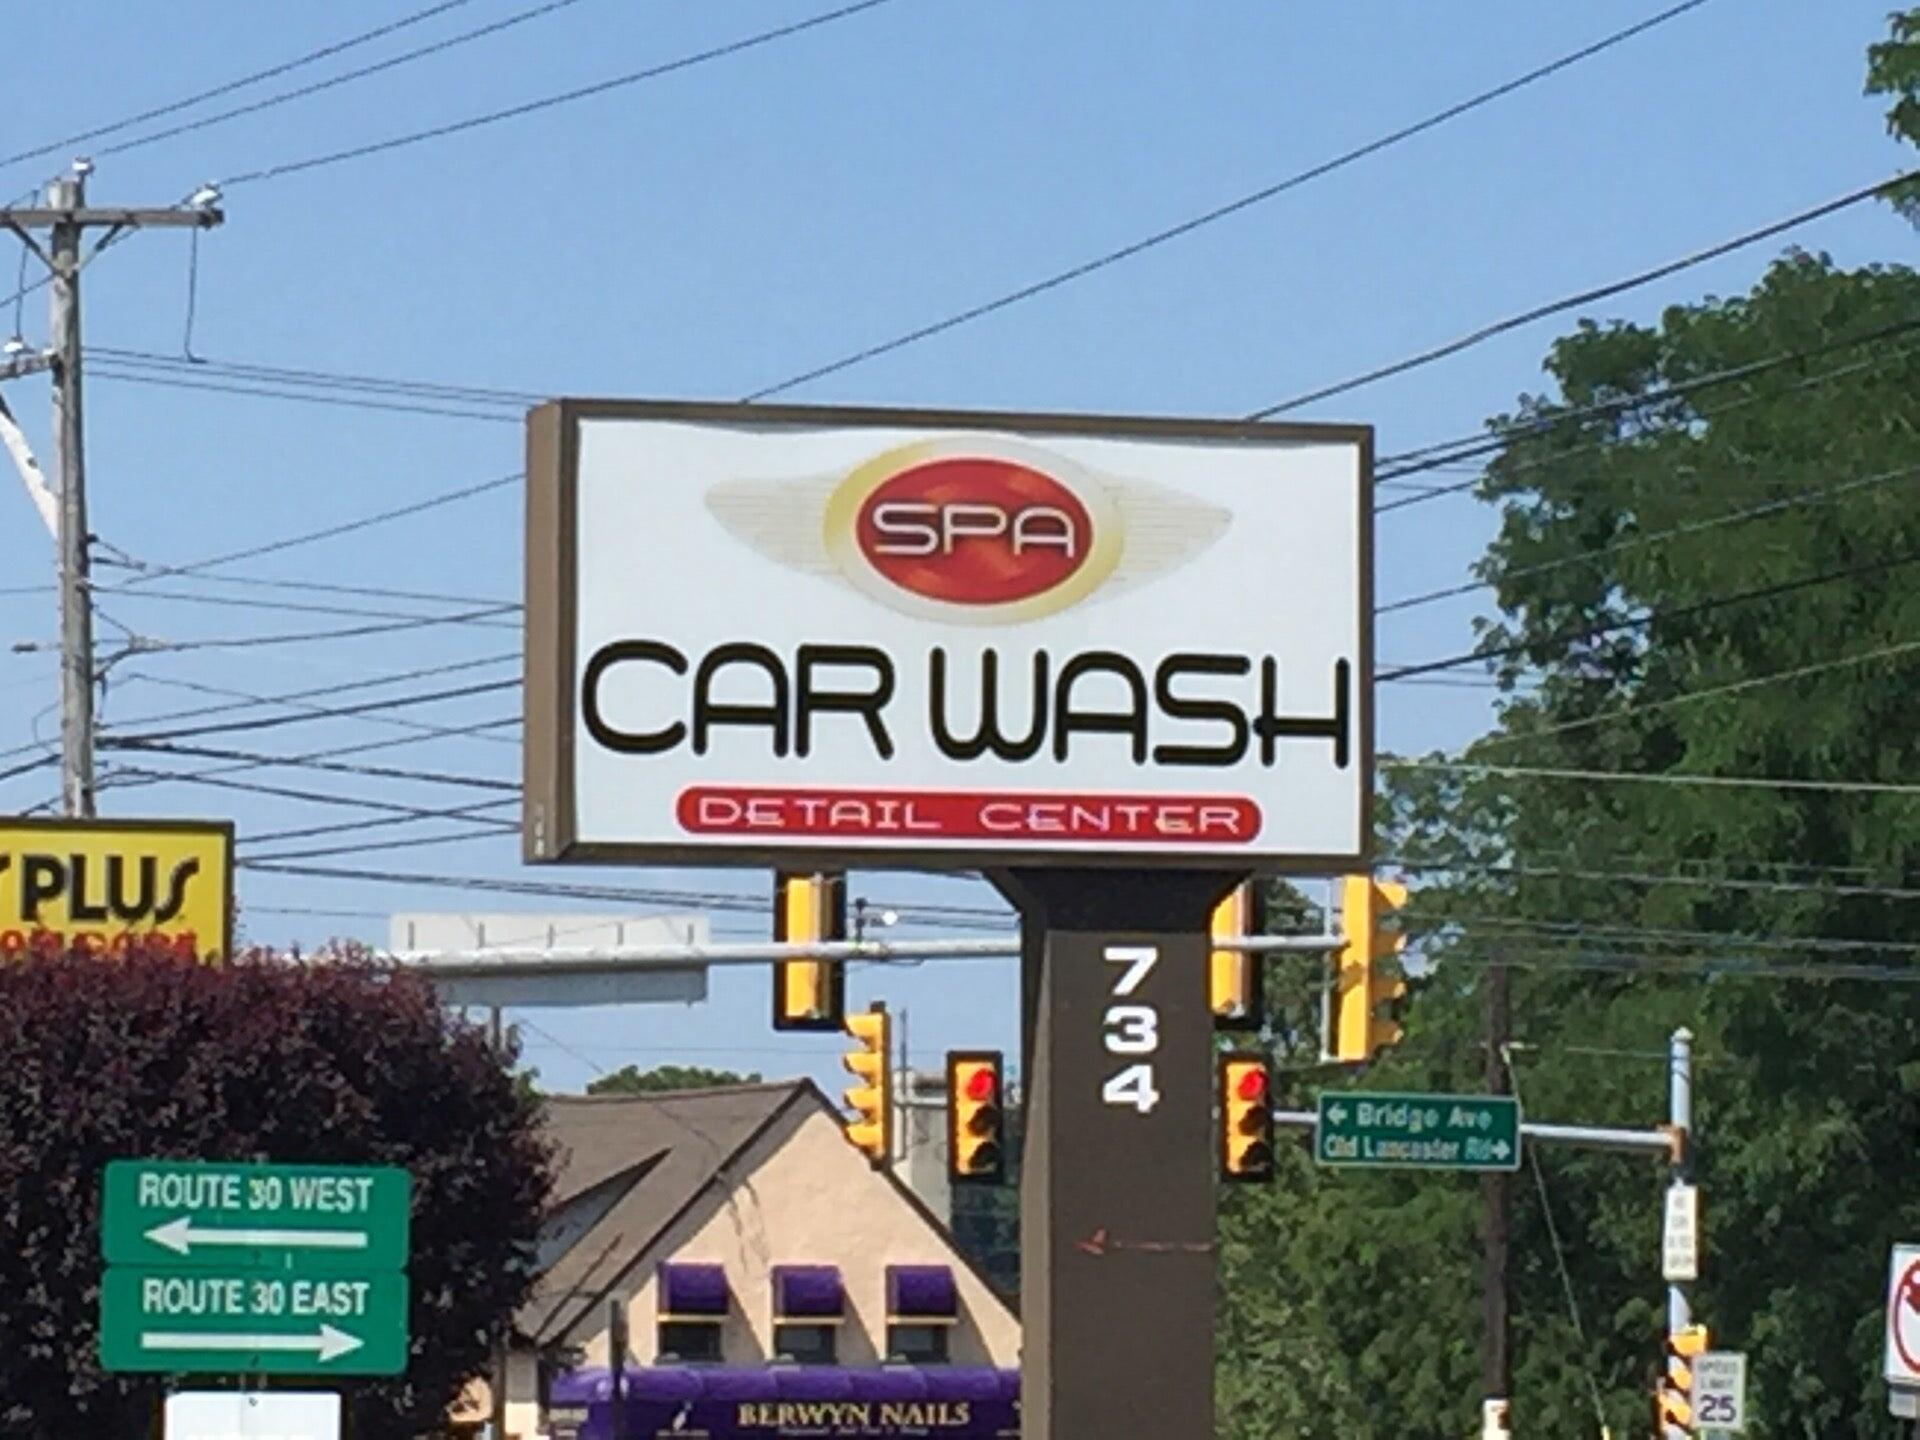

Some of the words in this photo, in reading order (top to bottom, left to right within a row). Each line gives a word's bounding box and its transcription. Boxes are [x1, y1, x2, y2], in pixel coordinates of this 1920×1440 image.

[871, 502, 1076, 559] SPA
[581, 638, 894, 759] CAR
[929, 647, 1351, 769] WASH
[697, 797, 942, 832] DETAIL
[978, 801, 1241, 835] CENTER
[20, 853, 201, 924] PLUS
[1356, 1102, 1440, 1133] Bridge
[1448, 1105, 1493, 1129] Ave
[1324, 1133, 1358, 1158] Old
[1362, 1134, 1460, 1160] Lancaster
[1465, 1136, 1493, 1160] Rd
[138, 1172, 242, 1209] ROUTE
[248, 1176, 282, 1210] 30
[290, 1176, 373, 1213] WEST
[142, 1277, 245, 1314] ROUTE
[251, 1280, 285, 1315] 30
[291, 1281, 370, 1316] EAST
[737, 1402, 872, 1426] BERWYN
[879, 1402, 971, 1426] NAILS
[1699, 1394, 1737, 1422] 25
